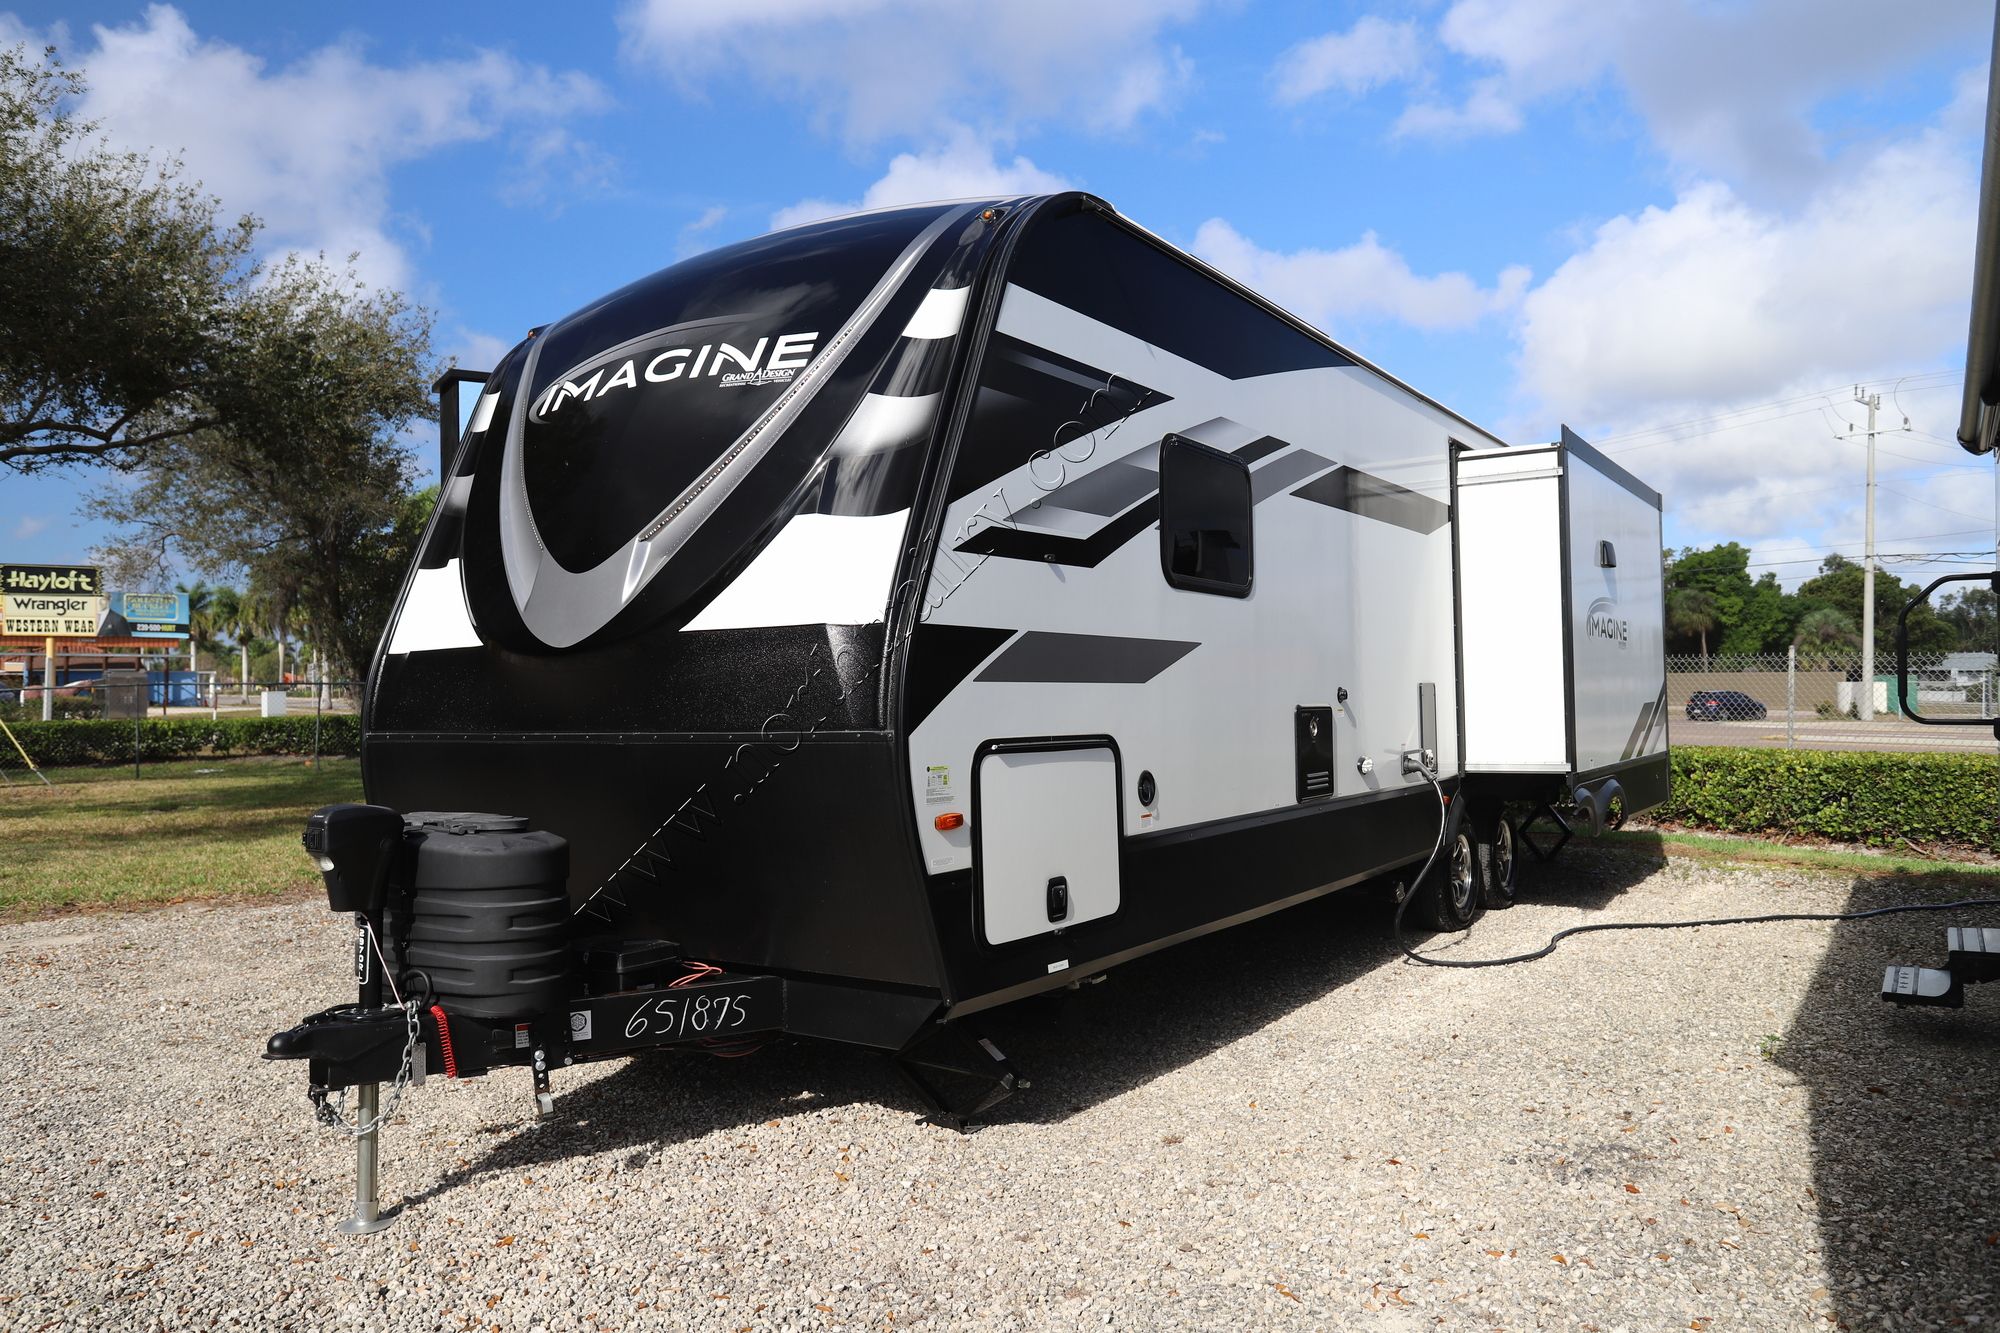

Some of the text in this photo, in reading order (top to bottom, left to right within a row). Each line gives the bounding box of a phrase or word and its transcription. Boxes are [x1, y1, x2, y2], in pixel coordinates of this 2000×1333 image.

[538, 331, 819, 416] IMAGINE
[721, 368, 796, 382] GRAND DESIGN
[6, 569, 94, 592] Hayloft
[13, 597, 88, 616] Wrangler
[6, 619, 94, 633] WESTERN WEAR
[1589, 615, 1628, 641] IMAGINE
[625, 994, 752, 1038] 651875
